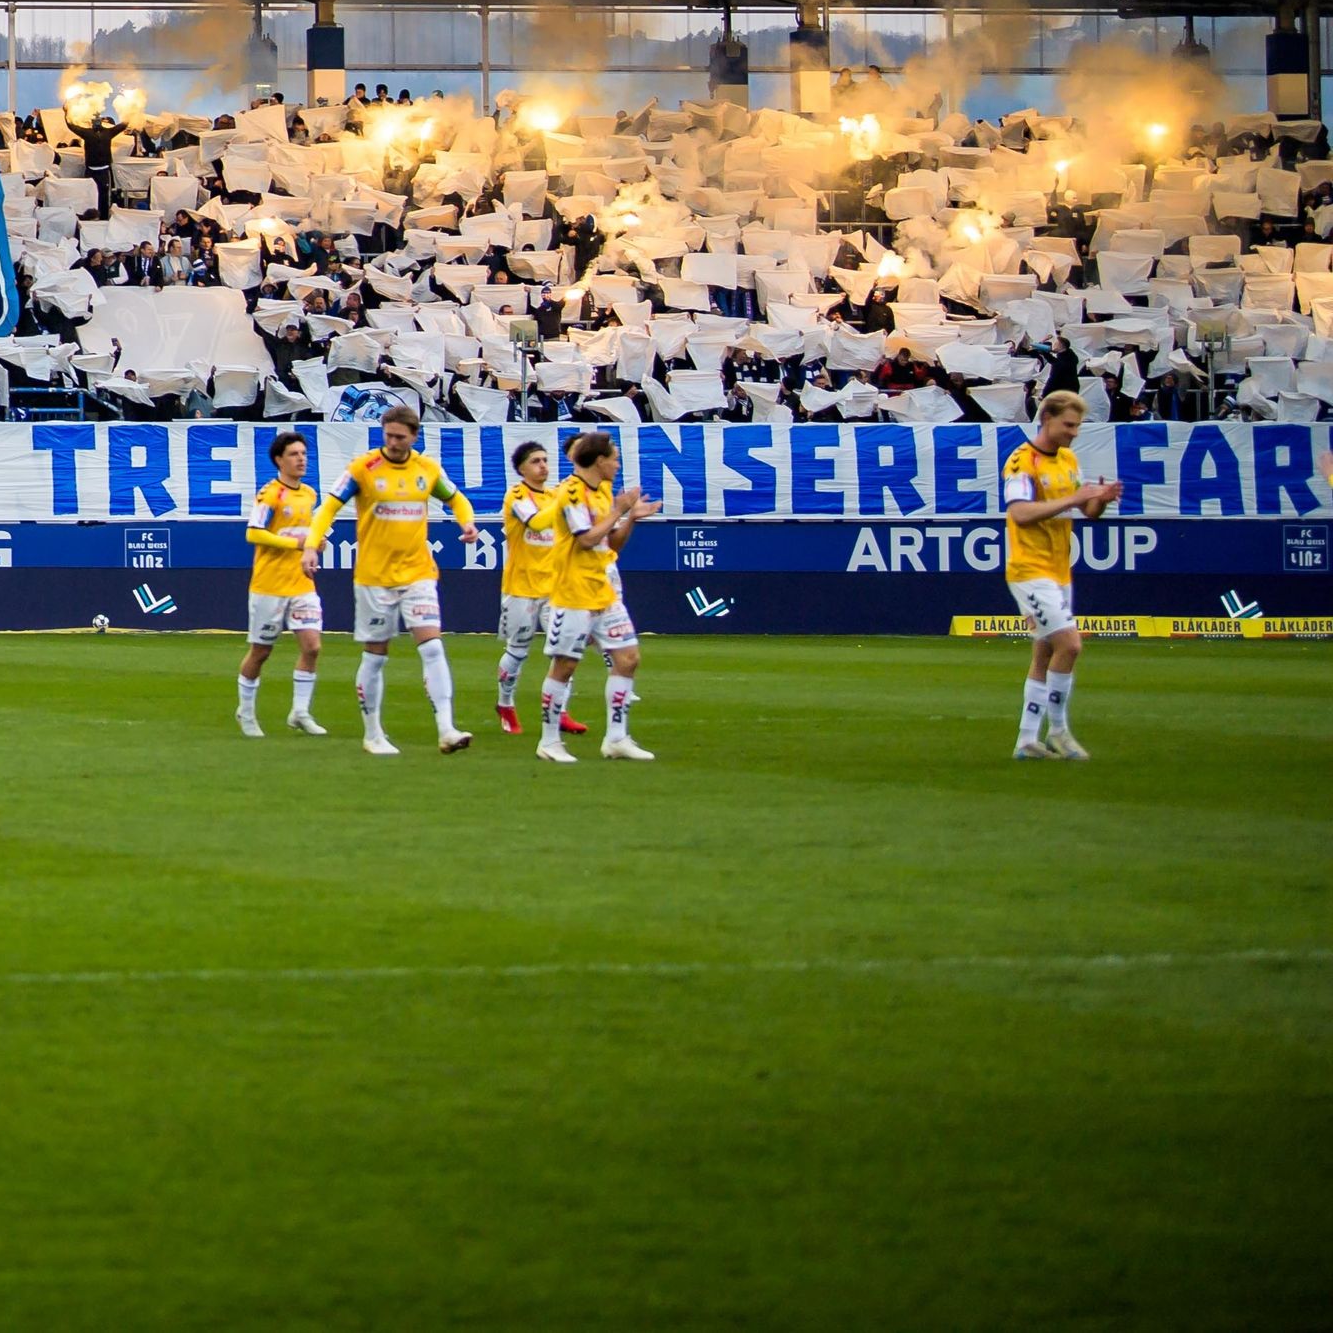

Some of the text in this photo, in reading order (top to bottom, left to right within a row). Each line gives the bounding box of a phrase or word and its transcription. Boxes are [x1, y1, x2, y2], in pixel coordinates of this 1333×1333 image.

[1115, 423, 1333, 516] FAR
[374, 503, 424, 516] Oberbank
[141, 532, 154, 542] FC
[692, 530, 704, 539] FC
[846, 526, 1158, 572] ARTGUP
[974, 617, 1028, 632] BLÅKLÄD
[1076, 617, 1137, 632] LÅKLÄDER
[1172, 619, 1242, 633] BLÅKLÄDER
